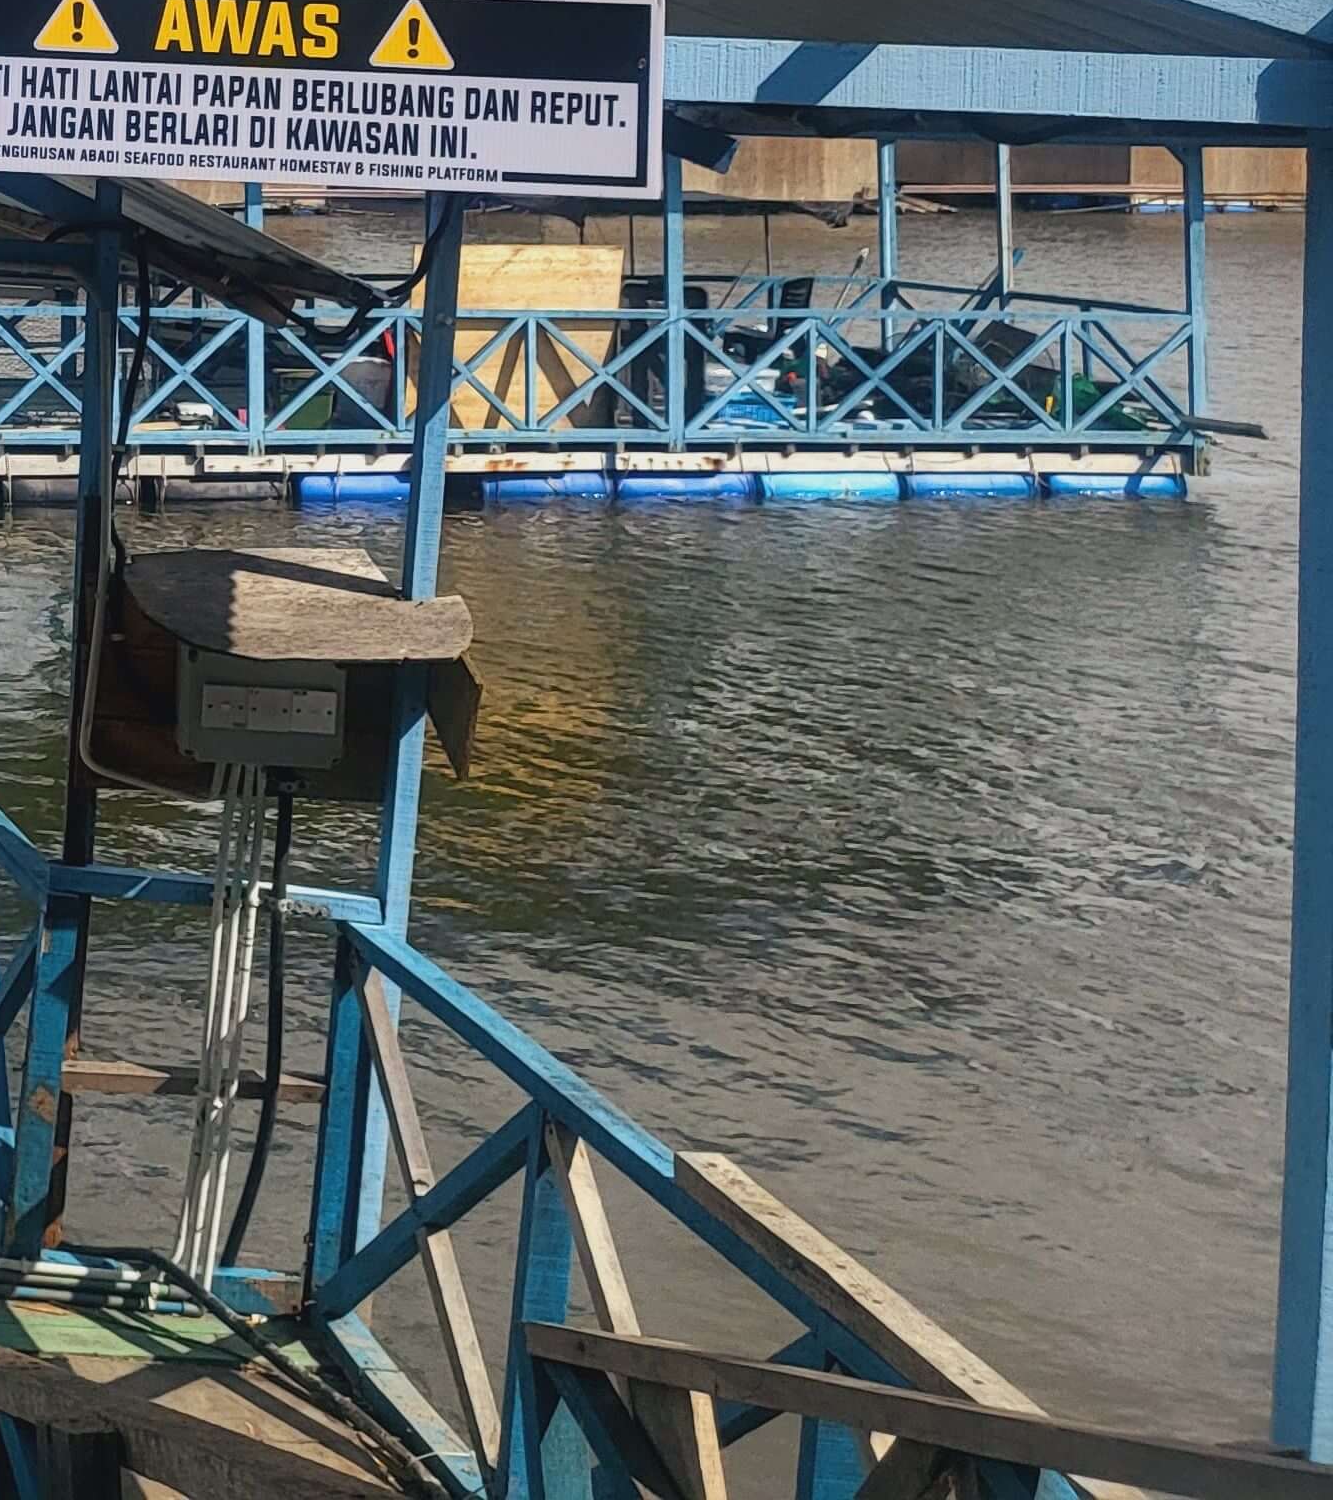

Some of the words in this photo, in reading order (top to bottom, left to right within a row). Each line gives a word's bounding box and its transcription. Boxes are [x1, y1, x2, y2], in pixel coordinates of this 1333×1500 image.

[20, 65, 79, 101] HATI
[89, 68, 182, 106] LANTAI
[192, 73, 282, 111] PAPAN
[292, 78, 455, 119] BERLUBANG
[464, 87, 520, 123] DAN
[530, 90, 626, 128] REPUT.
[6, 102, 115, 142] JANGAN
[125, 109, 239, 148] BERLARI
[249, 115, 276, 149] DI
[285, 117, 420, 157] KAWASAN
[430, 124, 478, 160] INI.
[79, 148, 120, 164] ABADI
[123, 150, 185, 167] SEAFOOD
[189, 154, 277, 171] RESTAURANT
[279, 158, 352, 175] HOMESTAY
[355, 161, 365, 176] &
[369, 162, 424, 179] FISHING
[427, 165, 498, 183] PLATFORM
